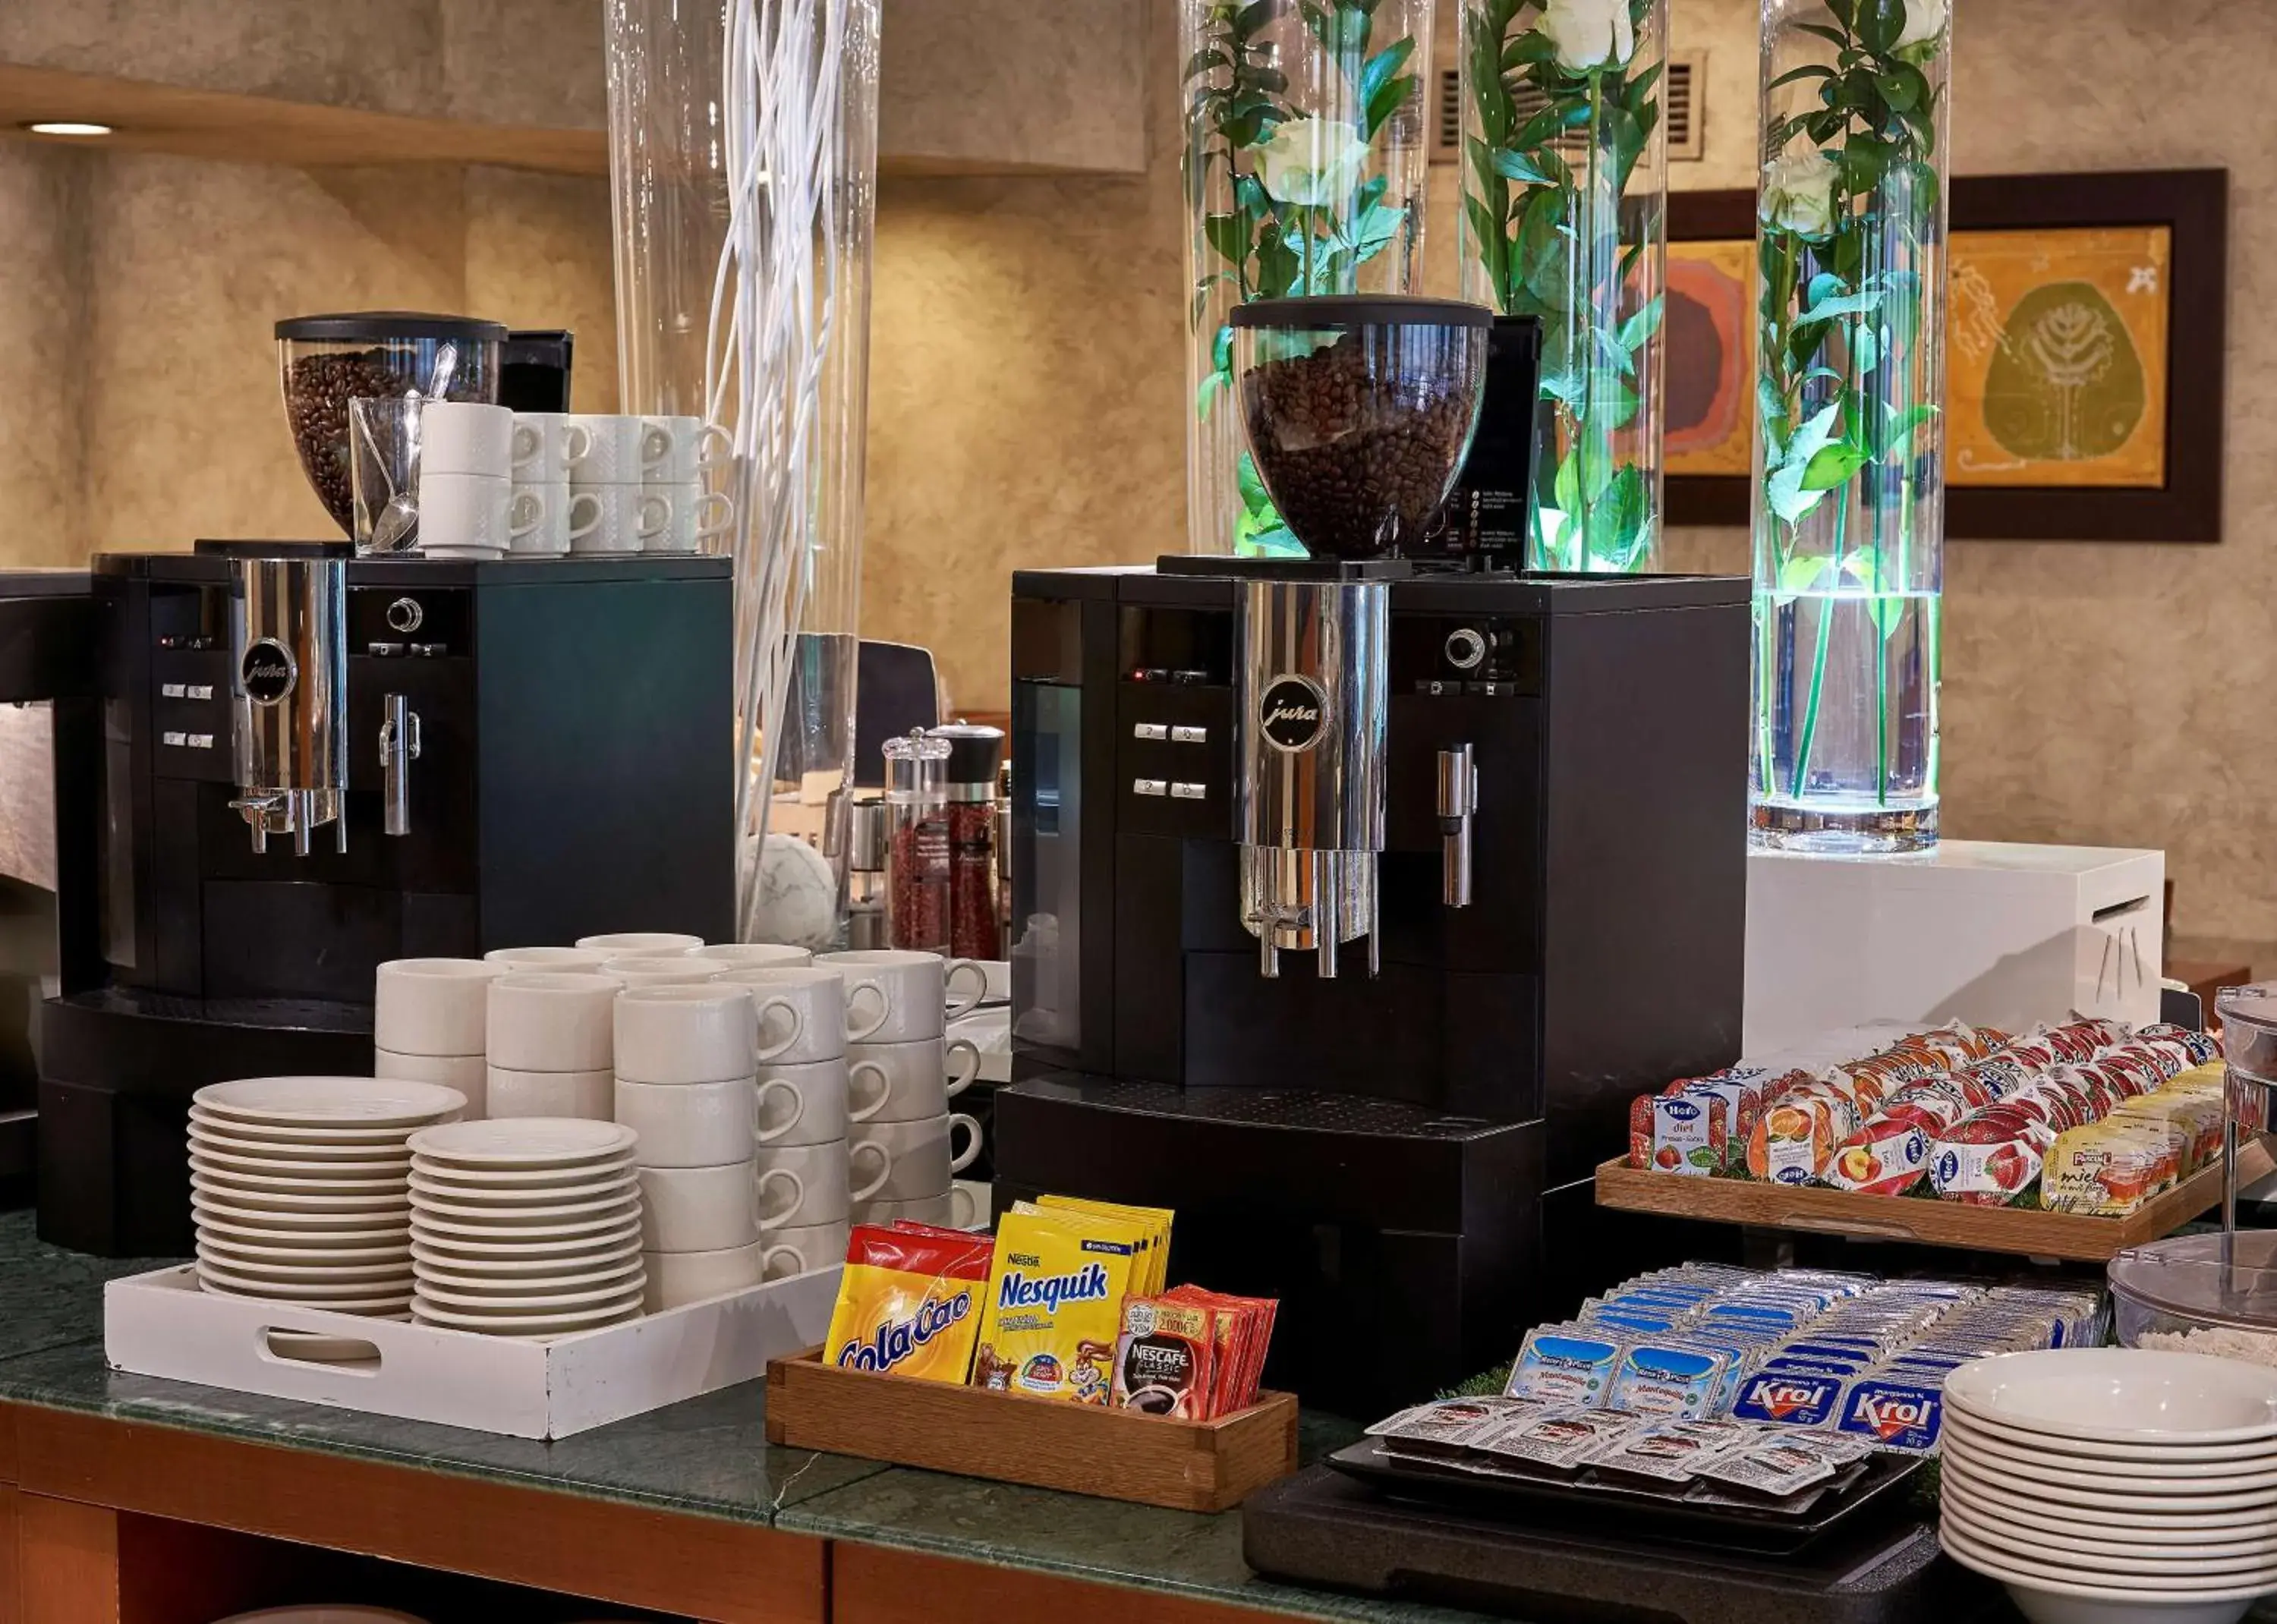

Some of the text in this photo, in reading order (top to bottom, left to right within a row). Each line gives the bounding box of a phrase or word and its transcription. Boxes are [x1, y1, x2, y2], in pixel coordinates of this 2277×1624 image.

[1264, 698, 1318, 727] jura
[1669, 1106, 1699, 1116] Hero
[1673, 1120, 1693, 1133] diet
[2061, 1167, 2101, 1183] miel
[998, 1263, 1107, 1314] Nesquik
[1138, 1361, 1181, 1373] CLASSIC
[1749, 1380, 1827, 1409] Krol
[1853, 1393, 1932, 1428] Krol
